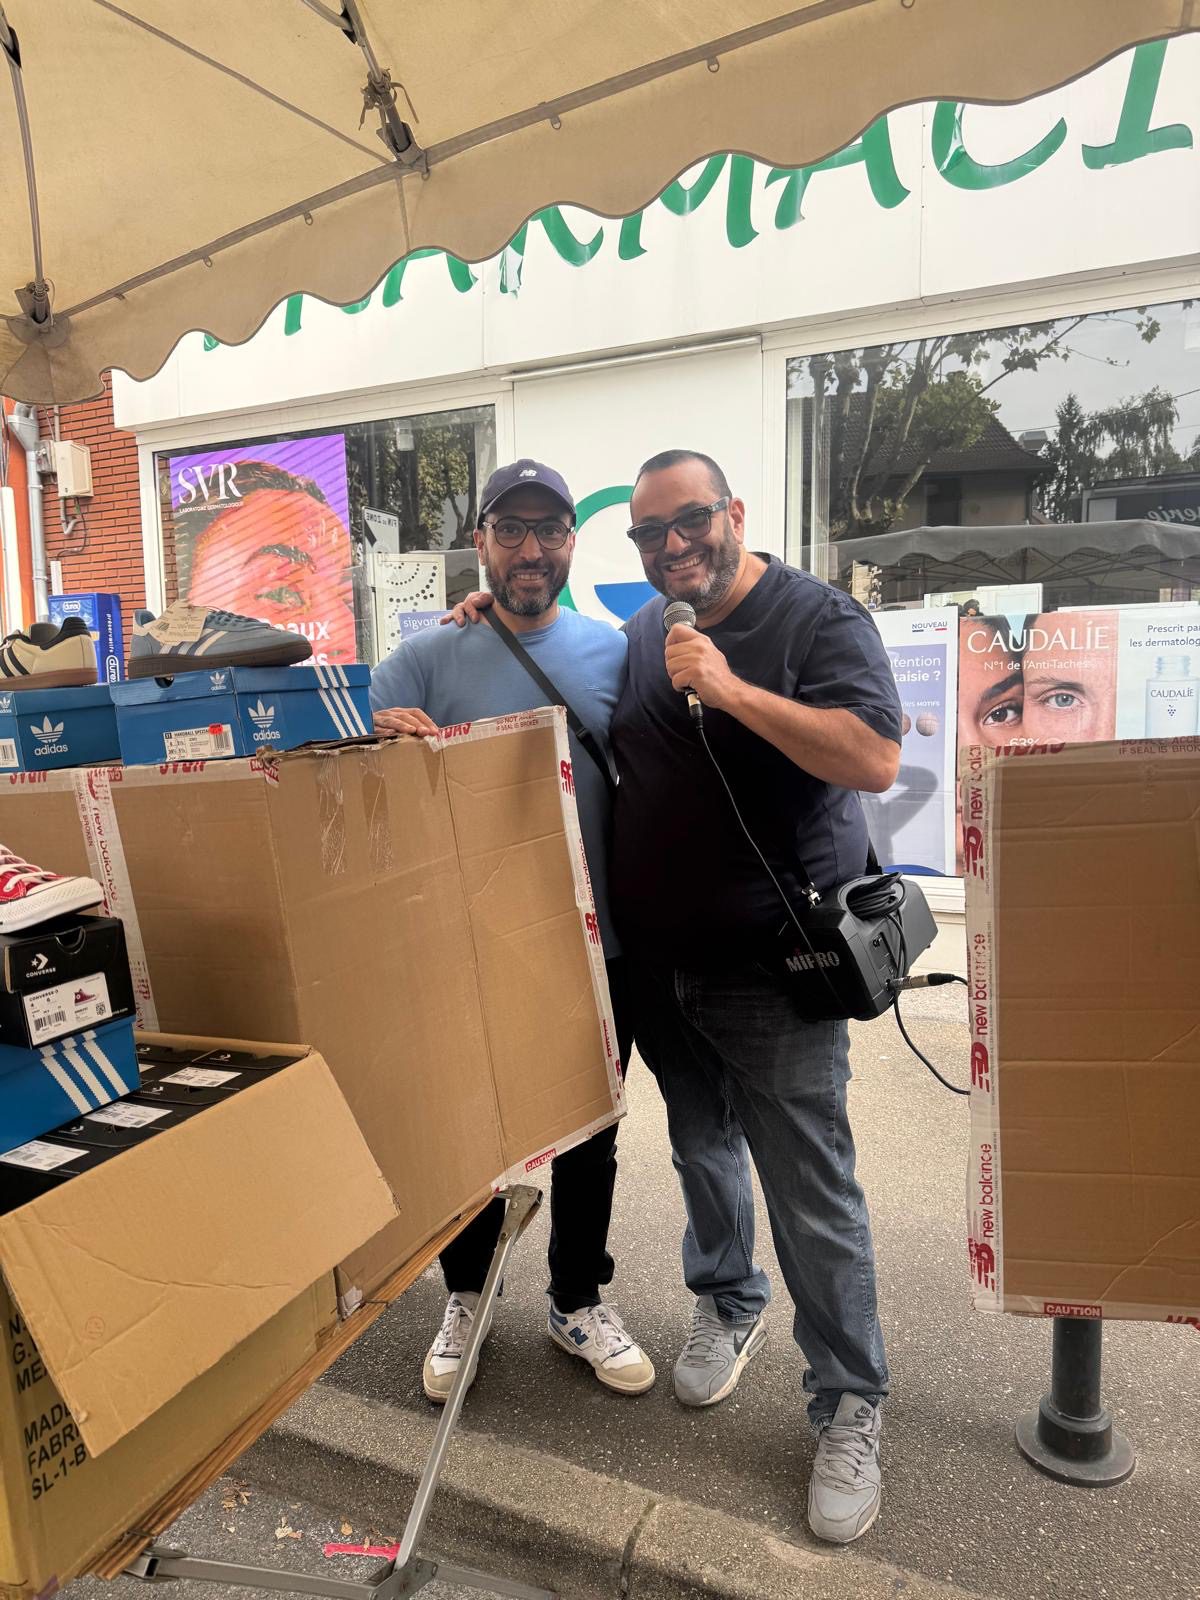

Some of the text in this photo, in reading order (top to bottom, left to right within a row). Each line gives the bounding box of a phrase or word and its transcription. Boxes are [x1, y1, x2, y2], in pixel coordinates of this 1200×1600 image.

[178, 463, 243, 504] SVR
[912, 621, 948, 629] NOUVEAU
[1147, 624, 1185, 633] Prescrit
[967, 621, 1110, 654] CAUDALÍE
[1129, 638, 1143, 648] les
[890, 655, 941, 668] tention
[1007, 661, 1021, 670] de
[253, 729, 281, 741] adidas
[34, 742, 69, 756] adidas
[25, 967, 57, 979] CONVERSE
[975, 1004, 988, 1036] new
[978, 1143, 994, 1206] balance
[980, 1208, 994, 1238] new
[1046, 1304, 1100, 1317] CAUTION
